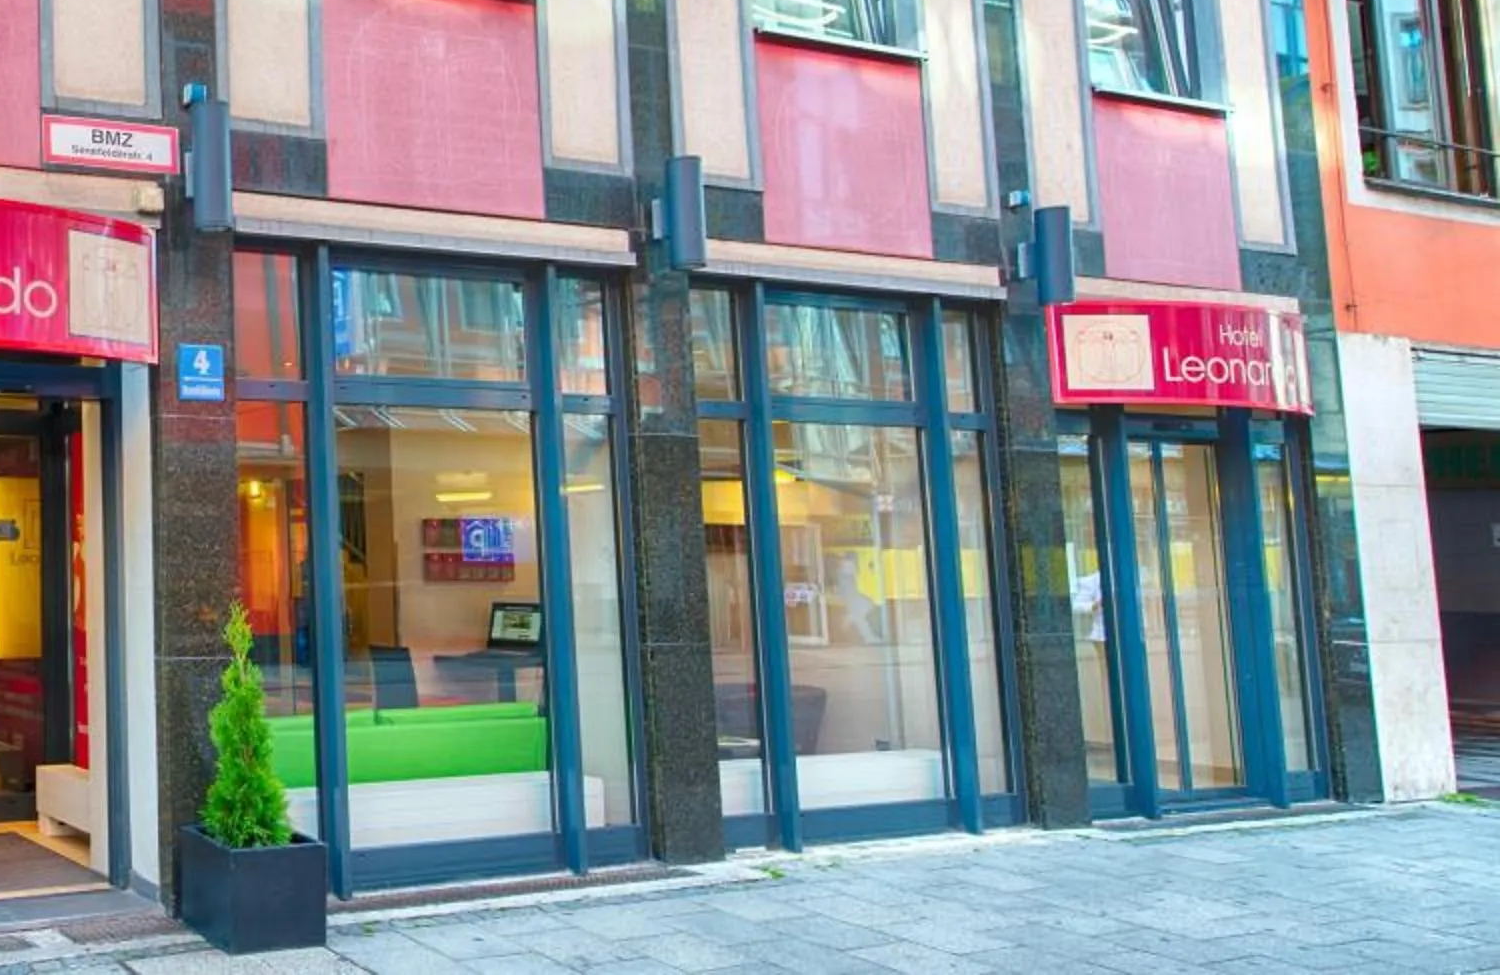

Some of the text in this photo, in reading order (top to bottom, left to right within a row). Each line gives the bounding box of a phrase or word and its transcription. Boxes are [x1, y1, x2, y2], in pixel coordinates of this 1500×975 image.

[91, 129, 133, 148] BMZ
[1219, 324, 1264, 348] Hotel
[193, 349, 210, 375] 4
[1163, 346, 1296, 386] Leonaro
